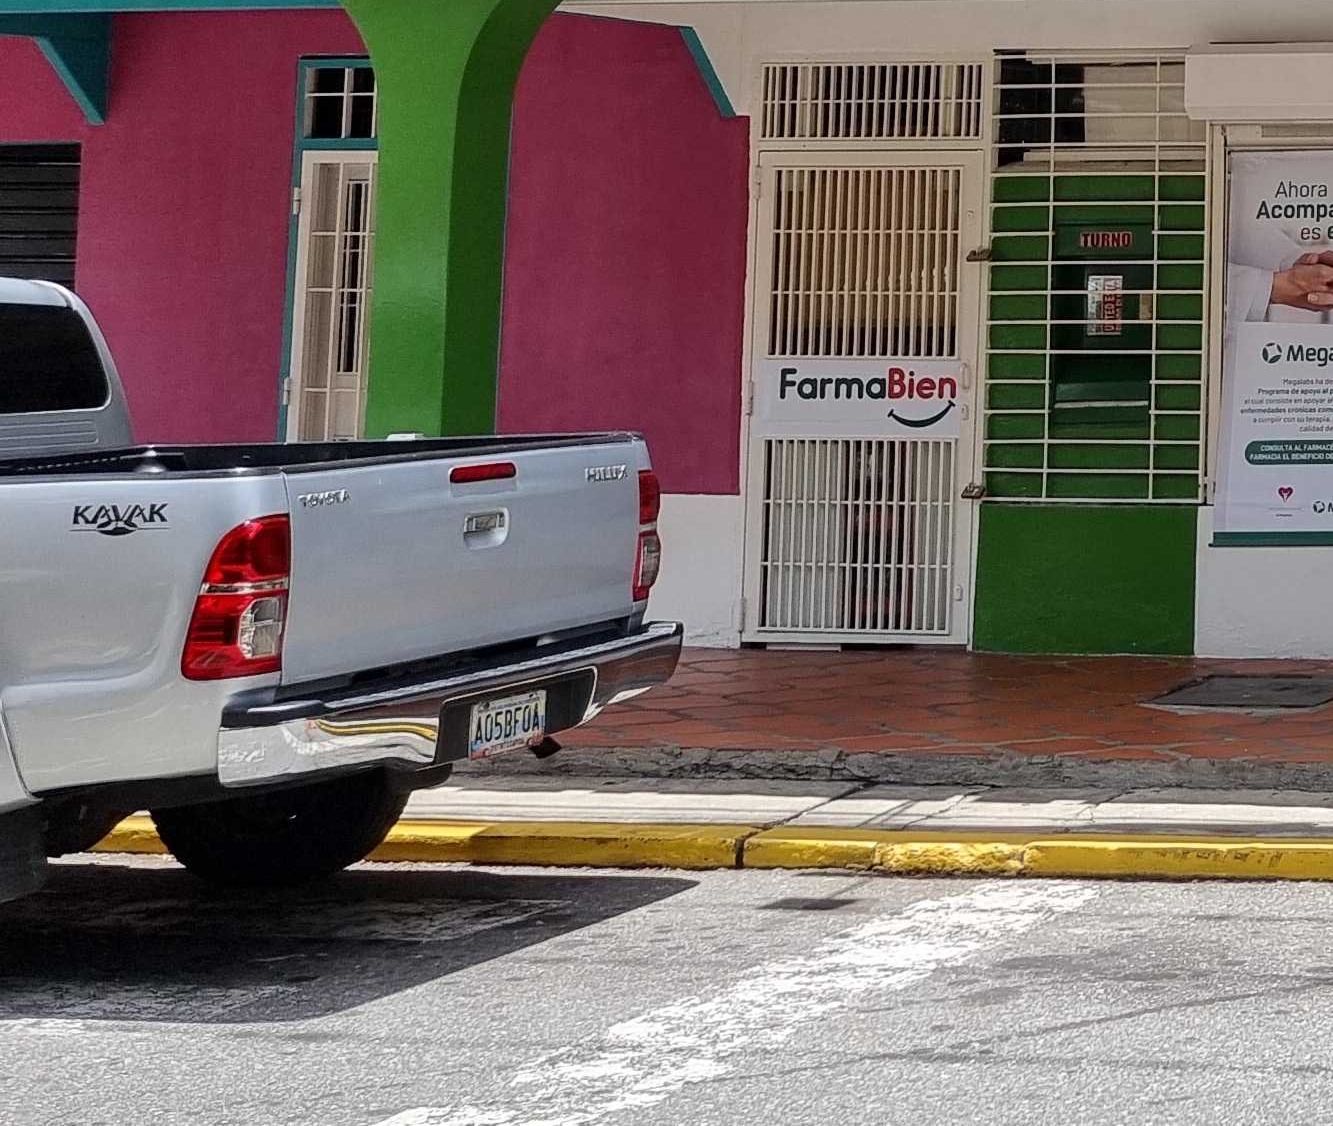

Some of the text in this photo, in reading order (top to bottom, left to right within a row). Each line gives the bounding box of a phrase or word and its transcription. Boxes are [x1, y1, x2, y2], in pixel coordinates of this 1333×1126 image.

[1274, 181, 1328, 198] Ahora
[1081, 232, 1132, 247] TURNO
[1300, 226, 1321, 240] es
[779, 367, 957, 400] FarmaBien
[584, 464, 628, 482] HILUX
[297, 488, 350, 507] TOYOTA
[72, 503, 169, 525] KAVAK
